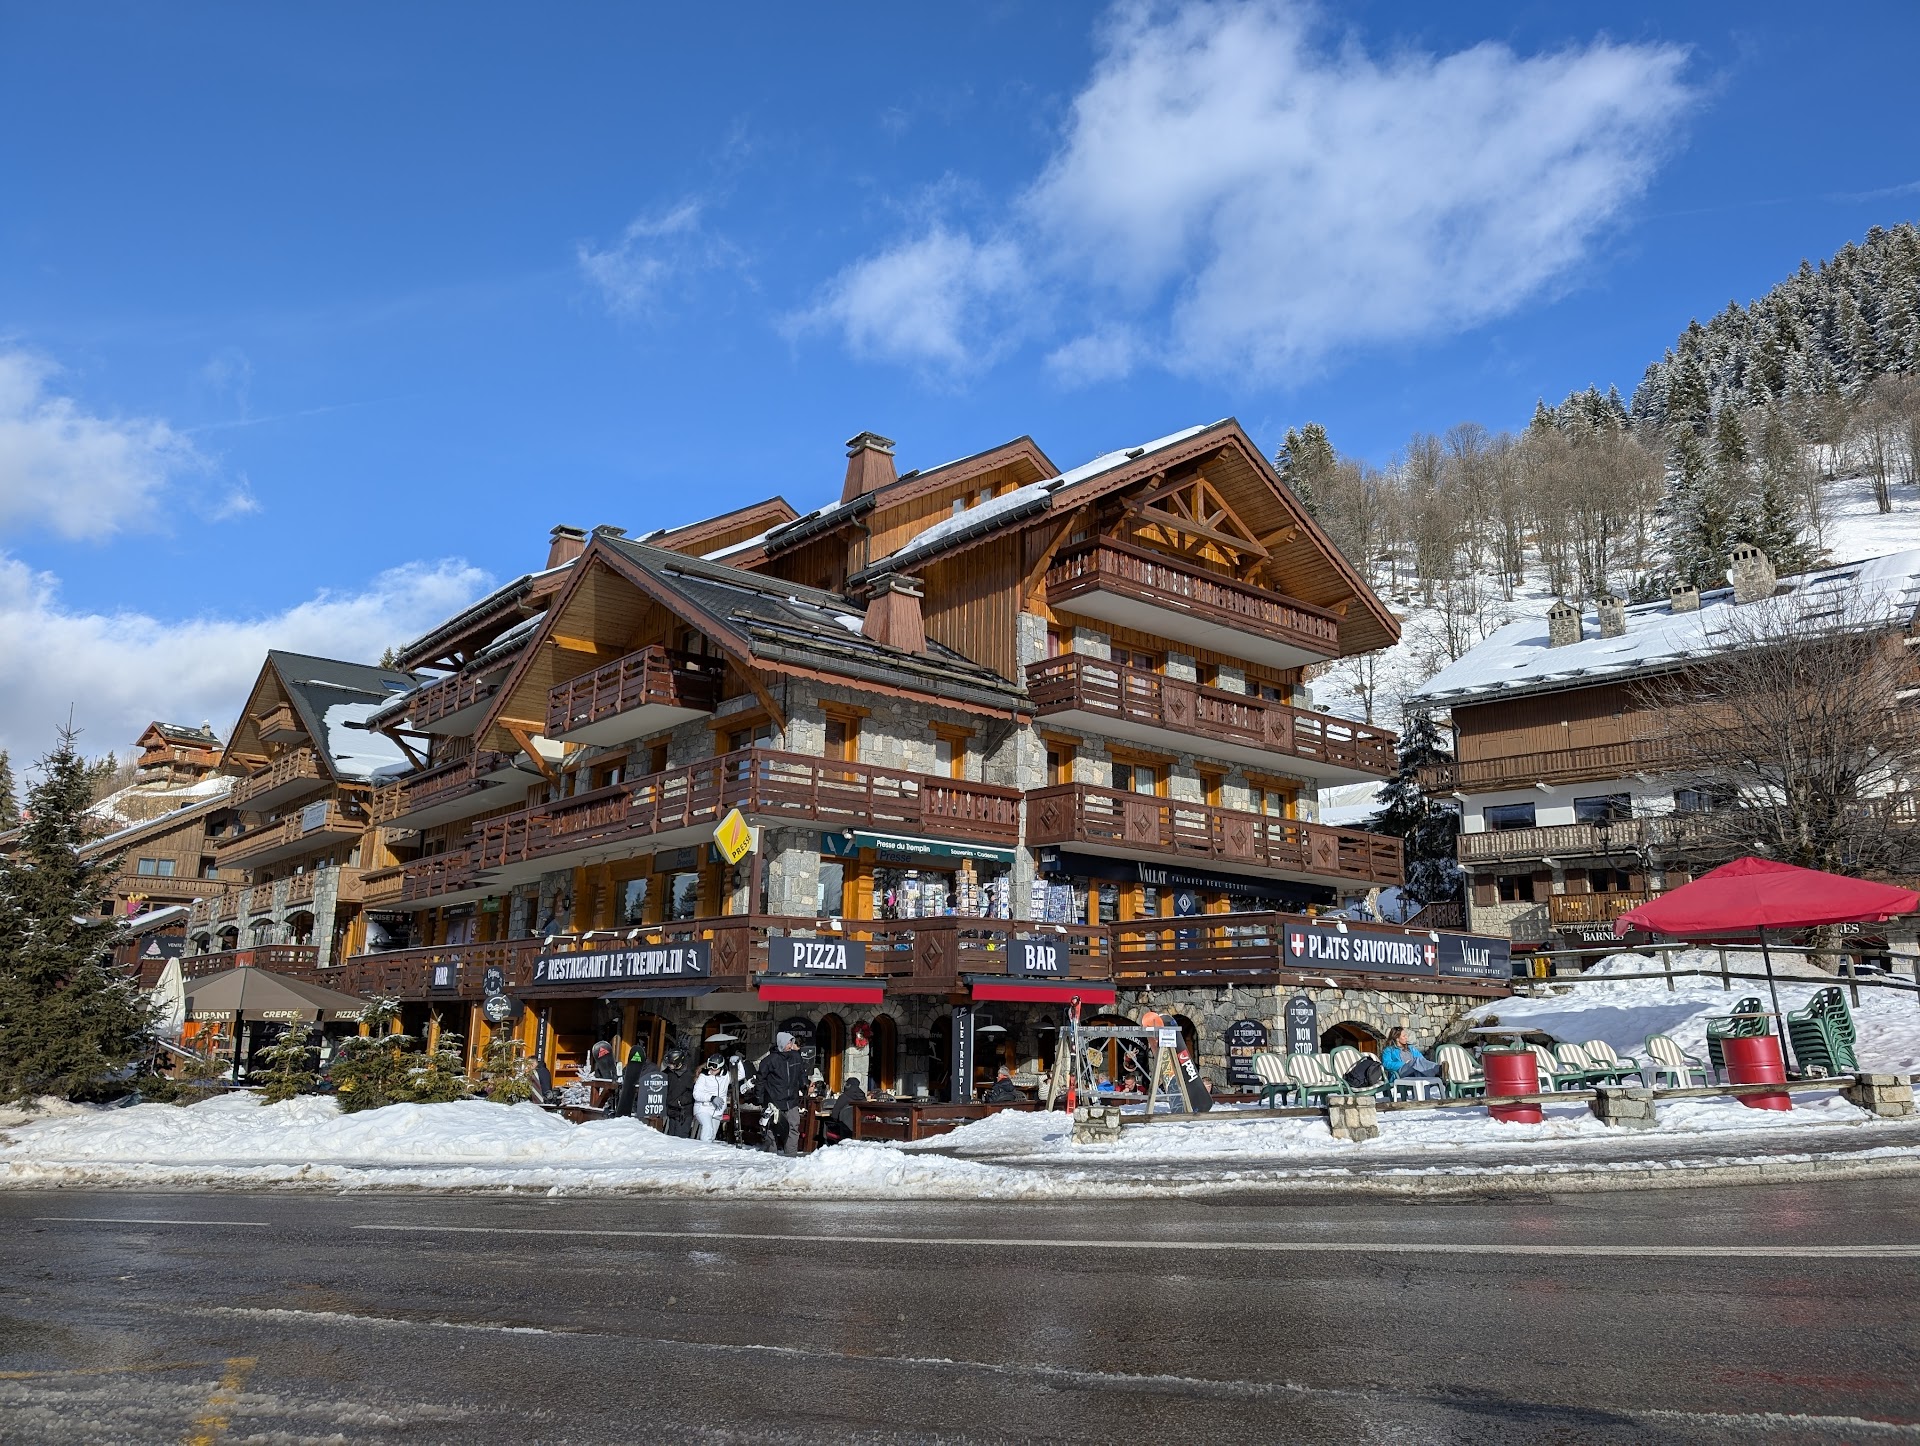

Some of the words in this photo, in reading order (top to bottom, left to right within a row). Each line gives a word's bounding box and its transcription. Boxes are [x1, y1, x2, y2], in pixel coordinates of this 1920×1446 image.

[731, 834, 752, 858] PRESSE
[876, 840, 896, 850] Presse
[896, 842, 906, 850] du
[906, 843, 931, 853] Tremplin
[879, 850, 912, 862] Presse
[950, 848, 974, 857] Souvenirs
[977, 851, 998, 860] Cadeaux
[1172, 876, 1202, 886] TAILORED
[1206, 880, 1222, 888] REAL
[1224, 882, 1248, 891] ESTATE
[369, 914, 396, 922] SKISET
[793, 942, 847, 970] PIZZA
[1307, 934, 1350, 960] PLATS
[1353, 938, 1422, 966] SAVOYARDS
[1024, 944, 1058, 970] BAR
[548, 954, 608, 980] RESTAURANT
[610, 953, 623, 976] LE
[626, 948, 684, 976] TREMPLIN
[435, 966, 448, 986] BAR
[262, 1010, 298, 1018] CREPES
[335, 1010, 360, 1018] PIZZAS
[960, 1021, 964, 1038] LE
[1296, 1028, 1310, 1040] NON
[1294, 1042, 1312, 1054] STOP
[648, 1094, 662, 1104] NON
[644, 1104, 664, 1114] STOP
